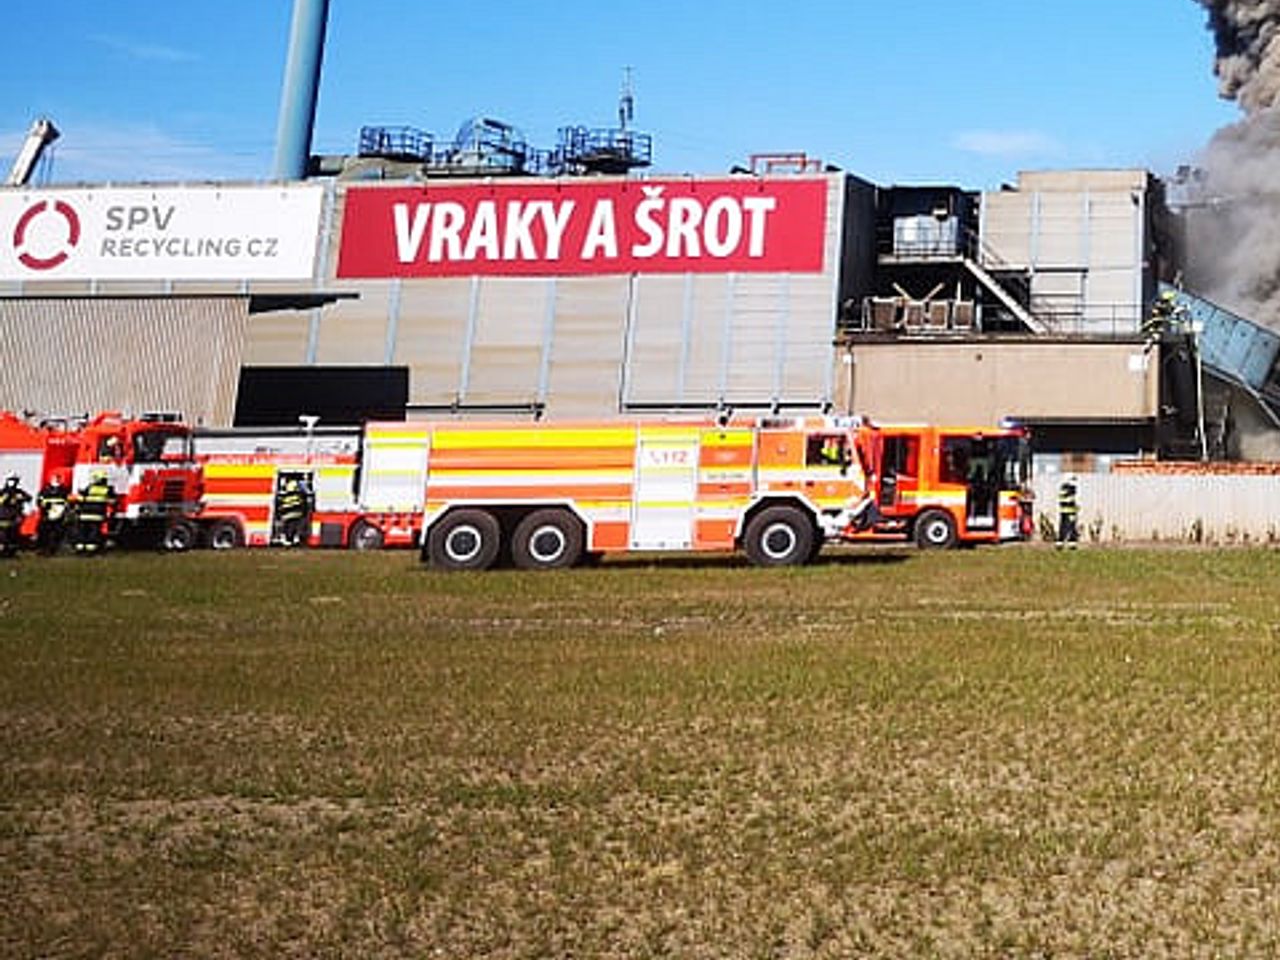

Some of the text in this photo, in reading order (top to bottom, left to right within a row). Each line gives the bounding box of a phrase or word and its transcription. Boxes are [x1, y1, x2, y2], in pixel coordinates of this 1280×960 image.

[105, 205, 175, 231] SPV
[393, 186, 776, 262] VRAKY A ŠROT
[100, 238, 279, 257] RECYCLING CZ
